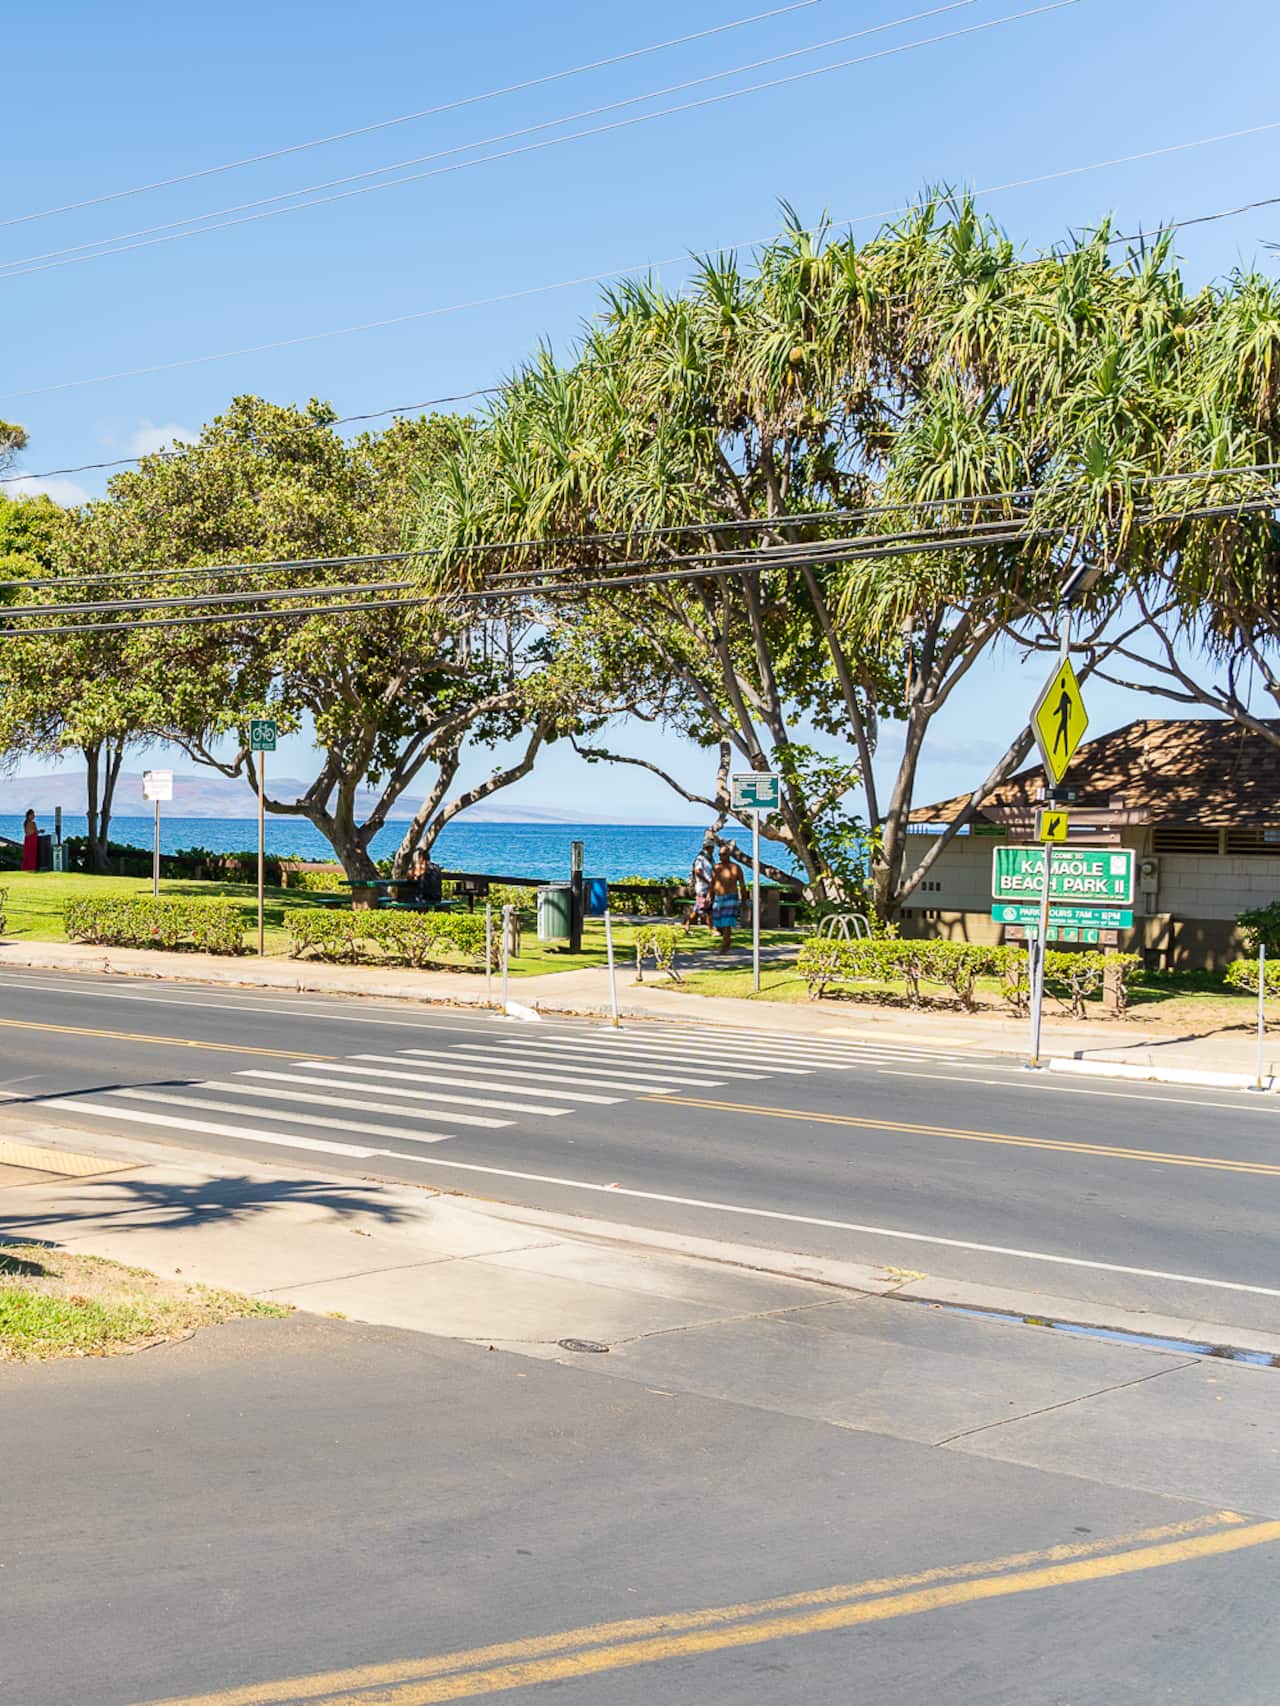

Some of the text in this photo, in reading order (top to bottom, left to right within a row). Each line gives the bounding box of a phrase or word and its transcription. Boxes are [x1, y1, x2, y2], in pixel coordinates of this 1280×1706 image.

[1021, 860, 1104, 877] KAMAOLE
[1000, 876, 1057, 891] BEACH
[1064, 878, 1109, 894] PARK
[1048, 909, 1072, 918] OURS
